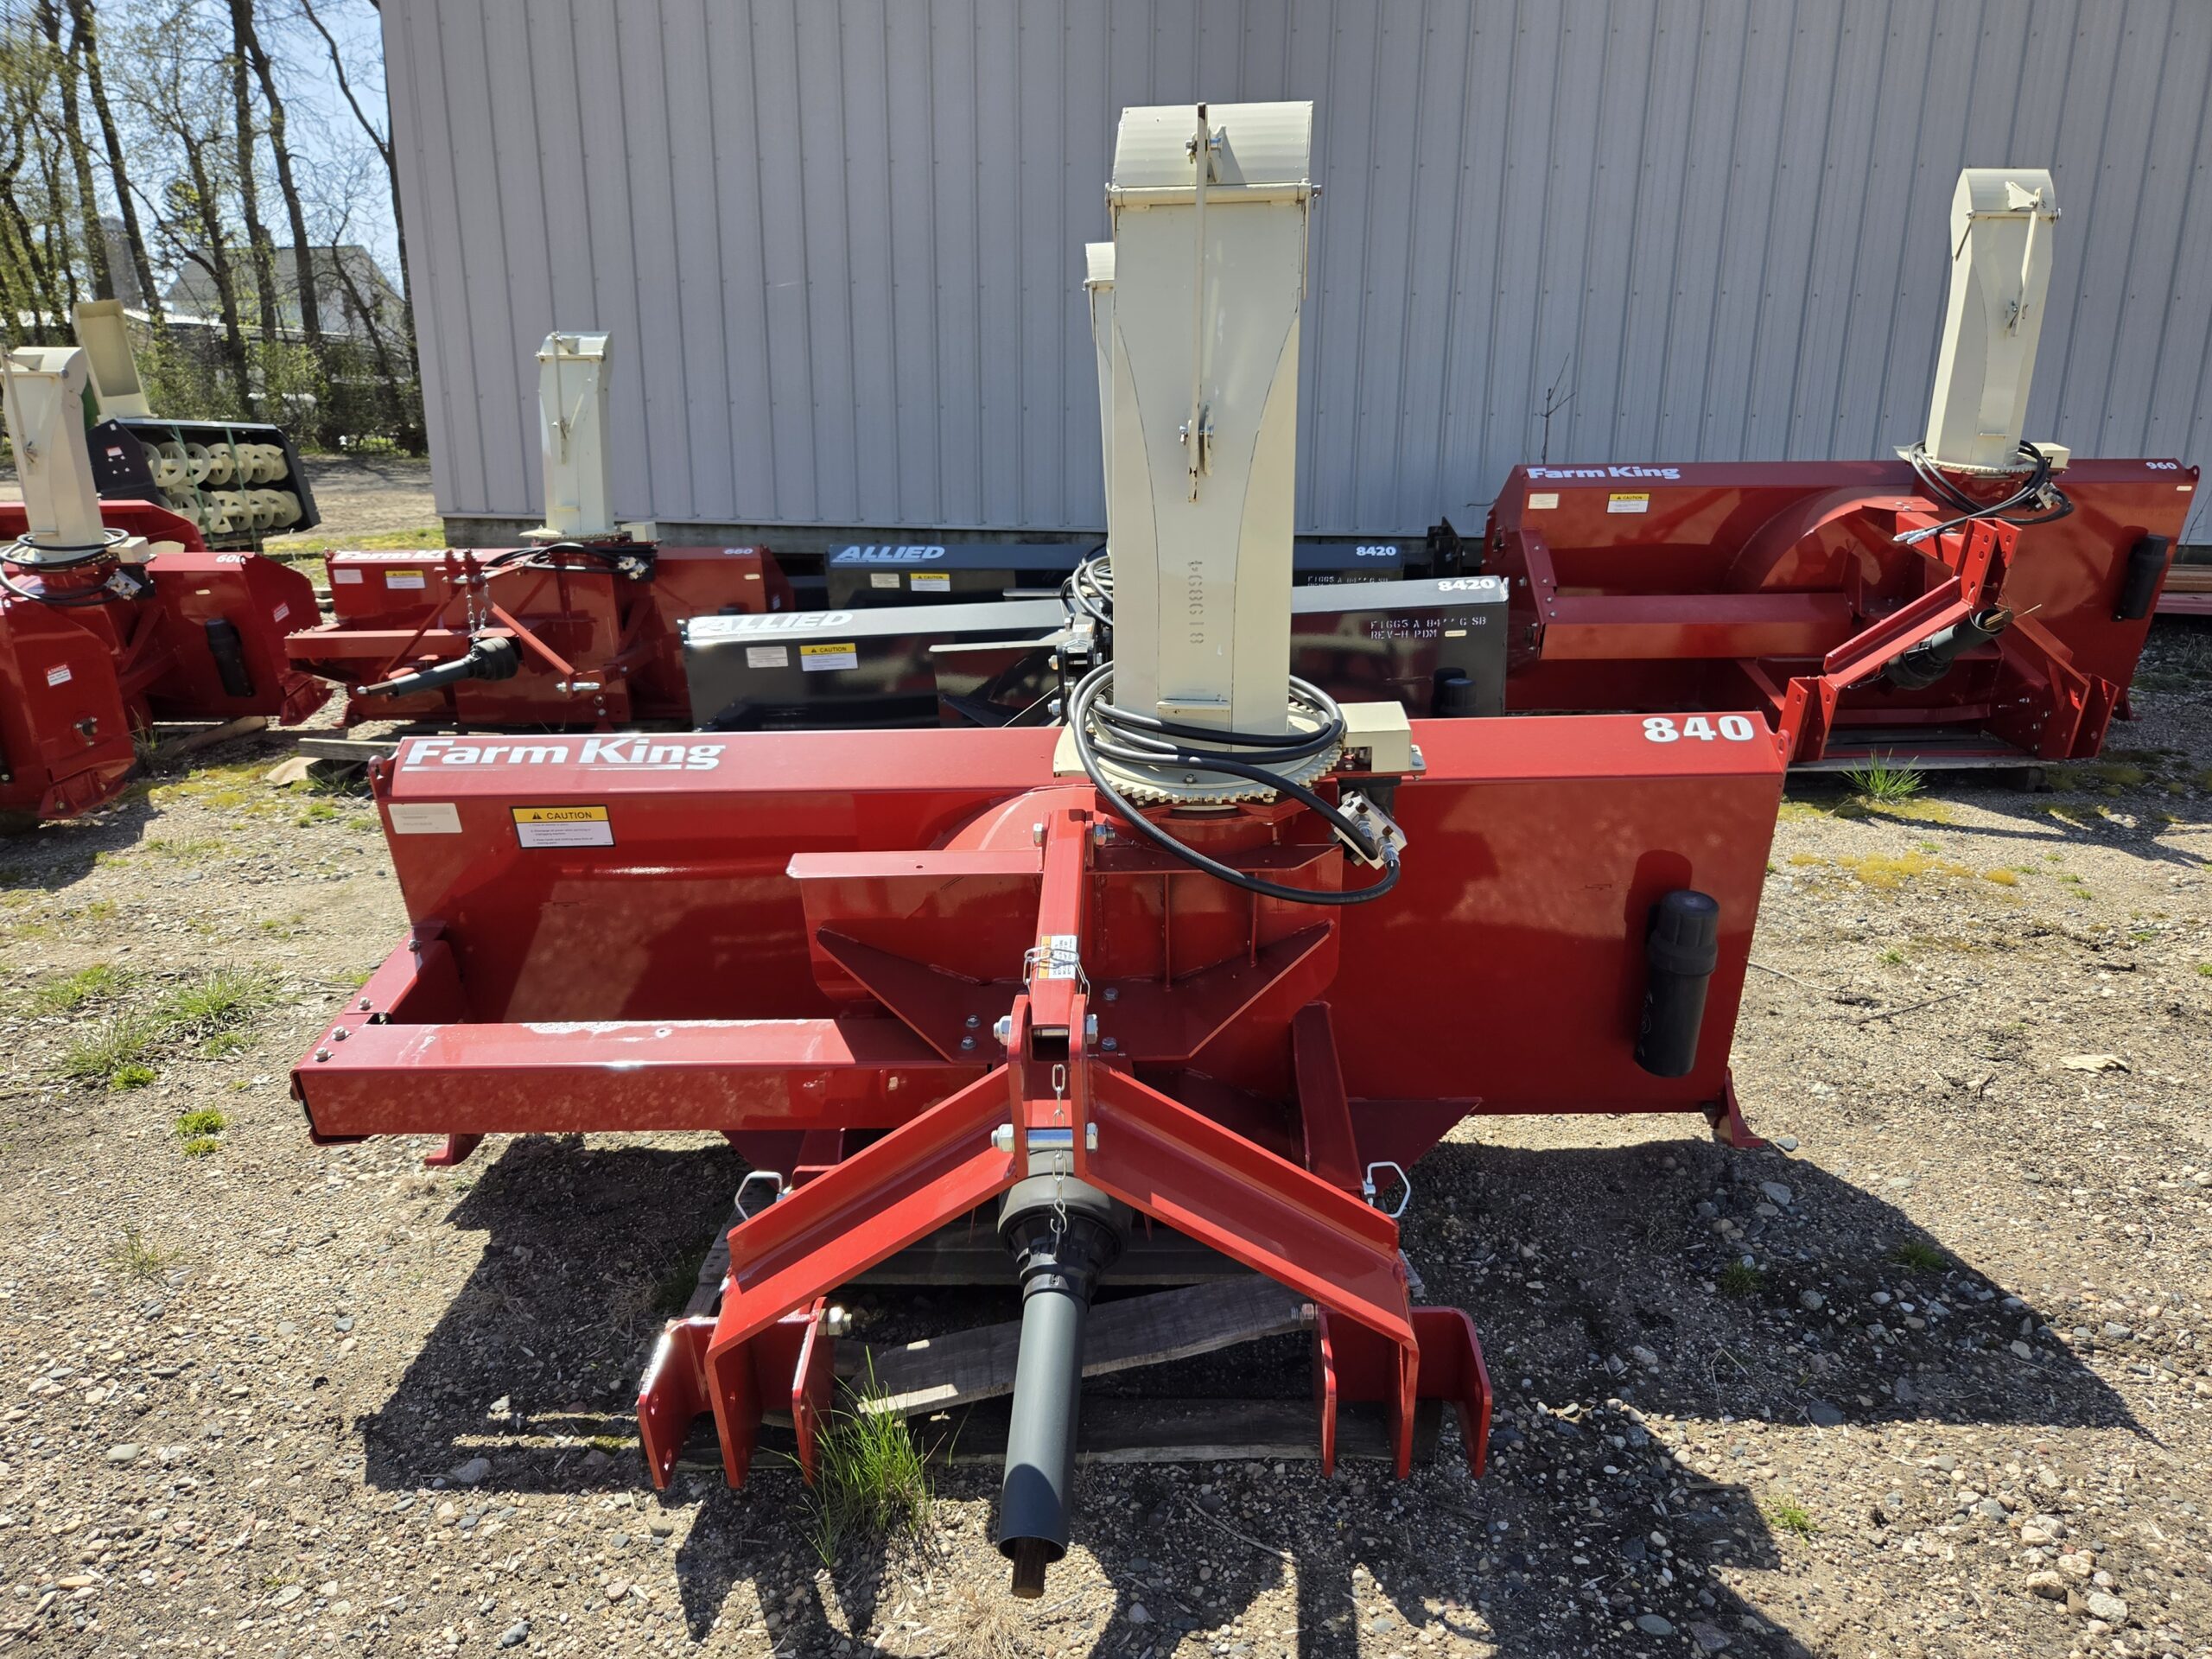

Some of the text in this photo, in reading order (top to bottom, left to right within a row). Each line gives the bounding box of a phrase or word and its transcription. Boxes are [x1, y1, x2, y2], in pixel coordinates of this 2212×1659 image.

[2145, 461, 2177, 470] 960
[1527, 467, 1681, 480] Farm King
[833, 546, 945, 559] ALLIED
[1356, 546, 1396, 556] 8420
[1438, 579, 1496, 592] 8420
[696, 613, 854, 632] ALLIED
[1413, 620, 1420, 628] A
[1471, 616, 1486, 626] SB
[1370, 630, 1408, 639] REV-H
[1414, 629, 1437, 639] PDM
[1643, 715, 1754, 742] 840
[405, 738, 726, 770] Farm King
[546, 811, 593, 820] CAUTION
